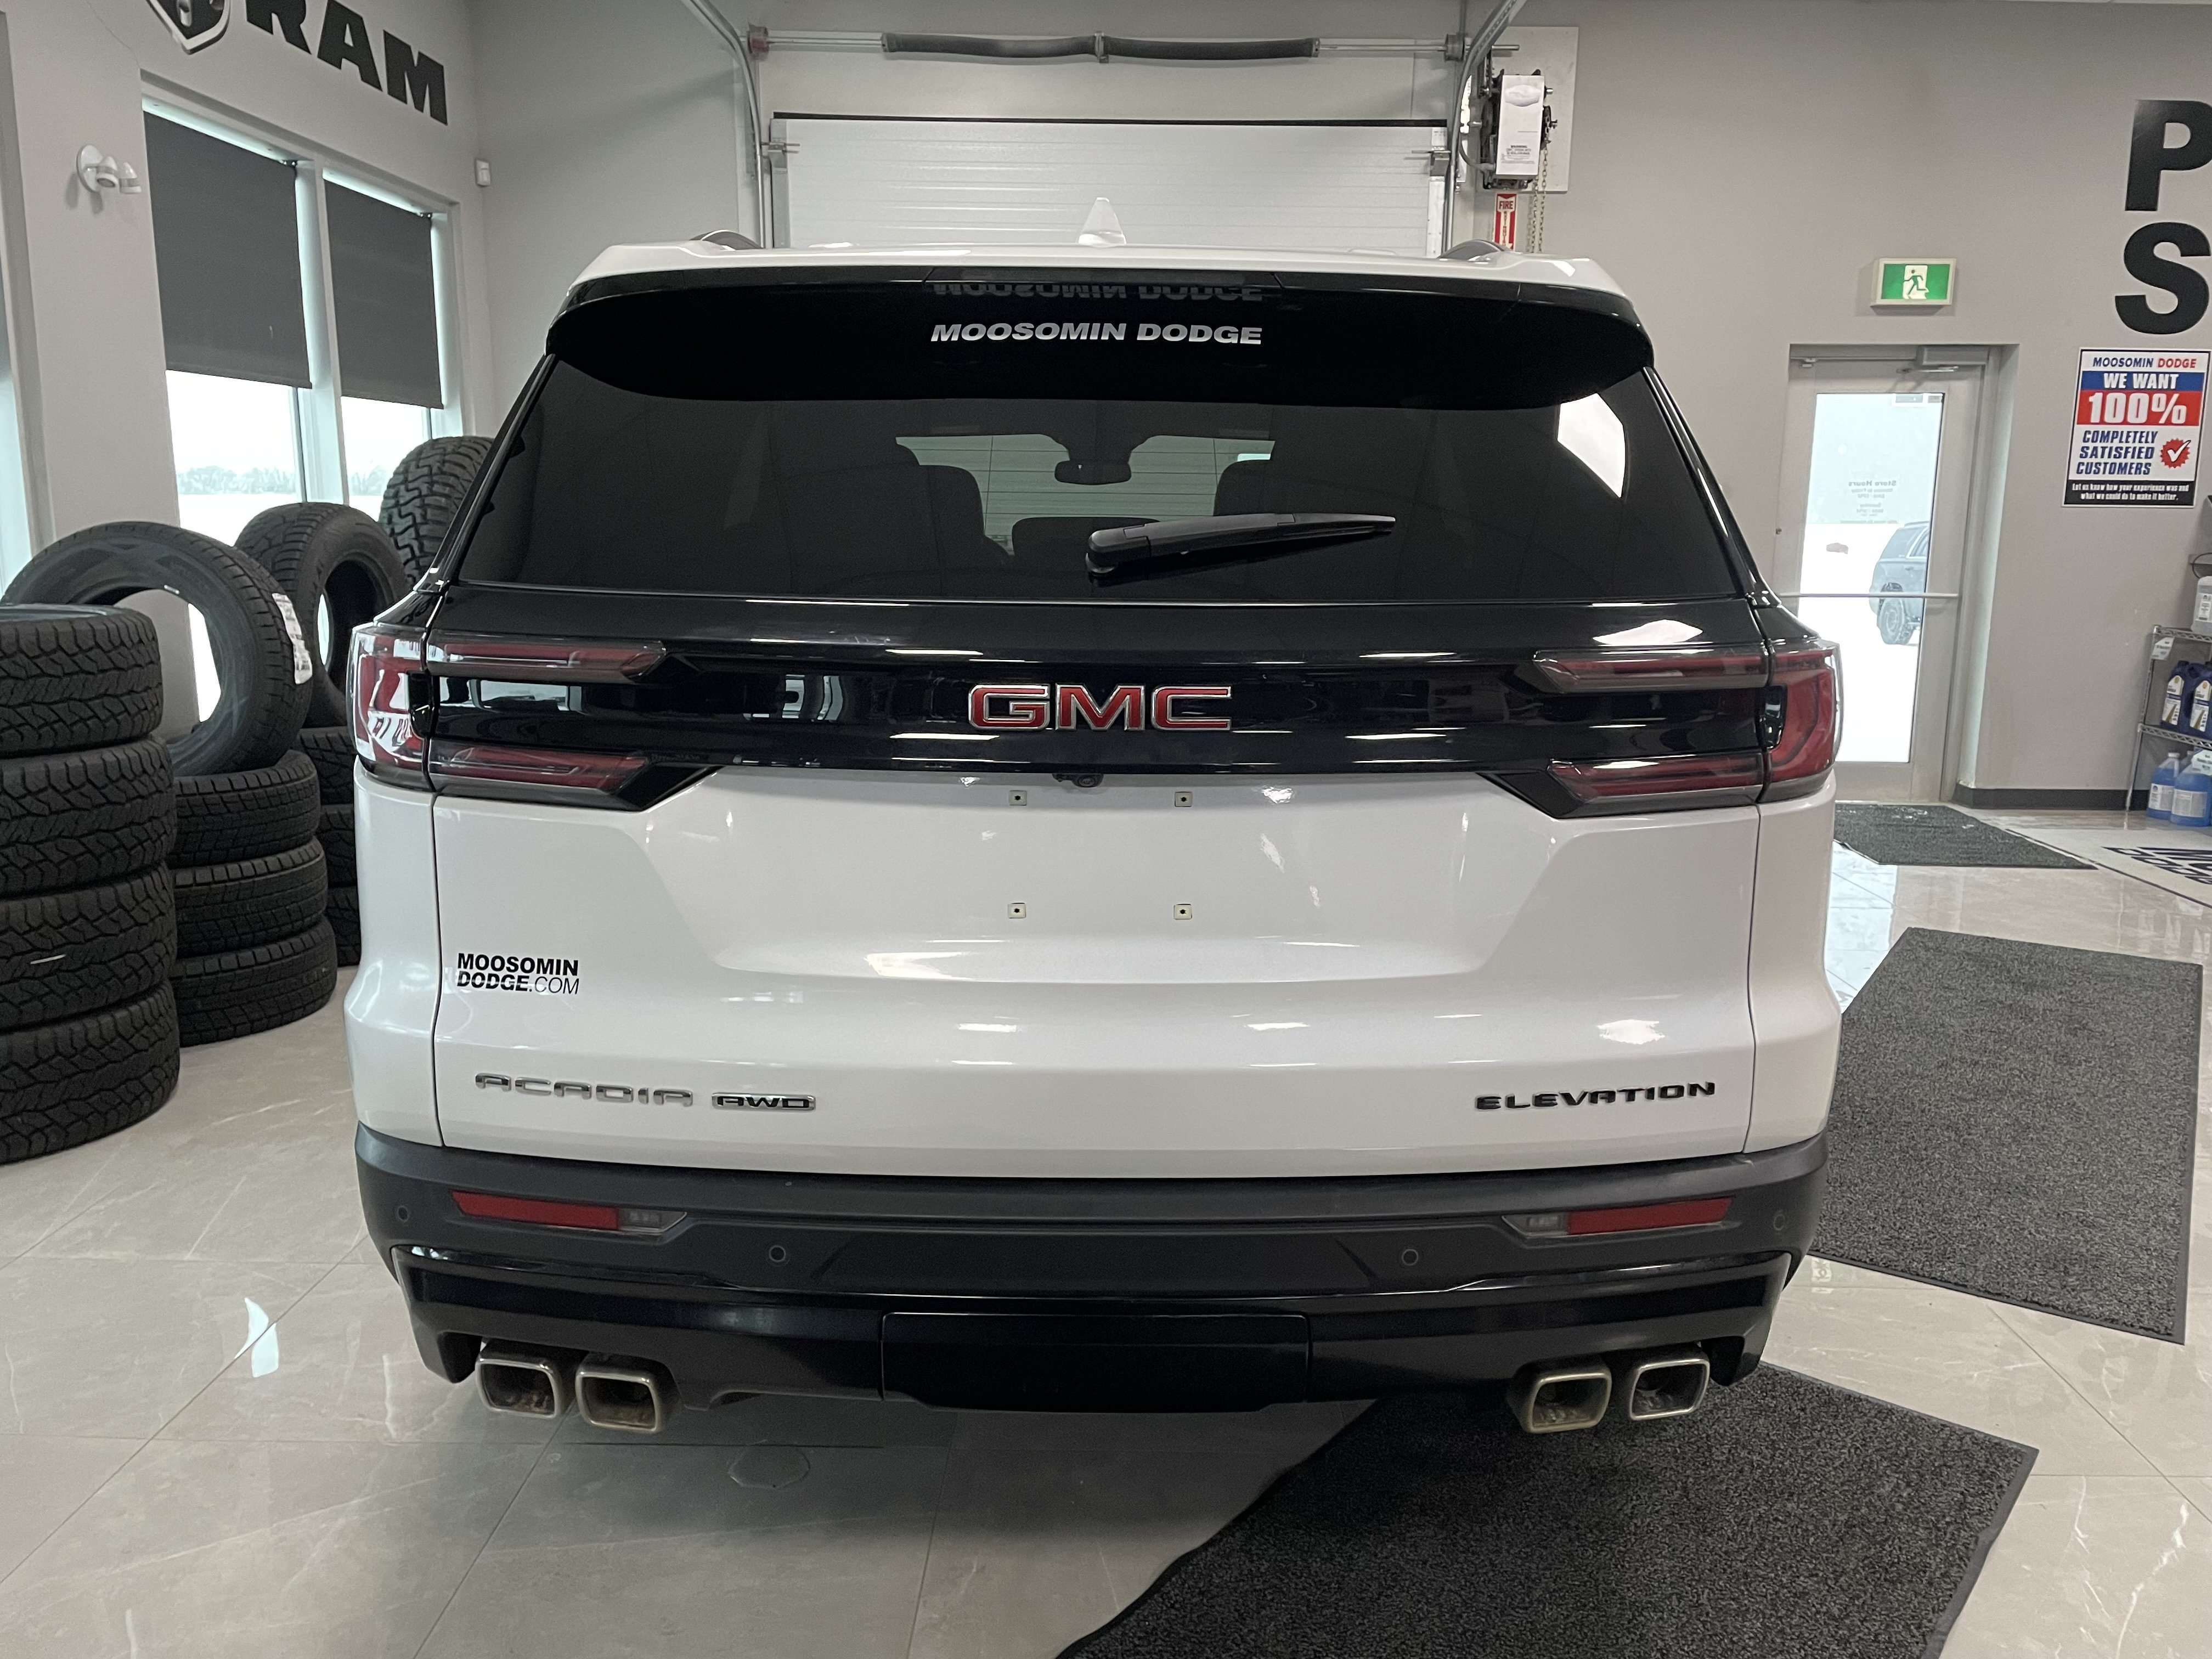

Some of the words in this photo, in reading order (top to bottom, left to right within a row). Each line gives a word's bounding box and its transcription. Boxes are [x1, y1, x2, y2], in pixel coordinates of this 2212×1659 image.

[245, 0, 448, 126] RAM
[1499, 201, 1513, 210] FIRE
[2114, 222, 2211, 334] S
[930, 323, 1126, 342] MOOSOMIN
[1137, 323, 1262, 345] DODGE
[2092, 357, 2154, 368] MOOSOMIN
[2157, 358, 2197, 369] DODGE
[2103, 373, 2128, 389] WE
[2132, 374, 2179, 389] WANT
[2089, 392, 2187, 424] 100%
[2082, 430, 2158, 444] COMPLETELY
[2079, 446, 2155, 459] SATISFIED
[2076, 462, 2152, 475] CUSTOMERS
[968, 682, 1232, 731] GMC
[457, 952, 579, 976] MOOSOMIN
[456, 970, 579, 995] DODGE.COM
[475, 1072, 693, 1107] ACADIA
[716, 1095, 812, 1109] AWD
[1475, 1081, 1716, 1110] ELEVATION
